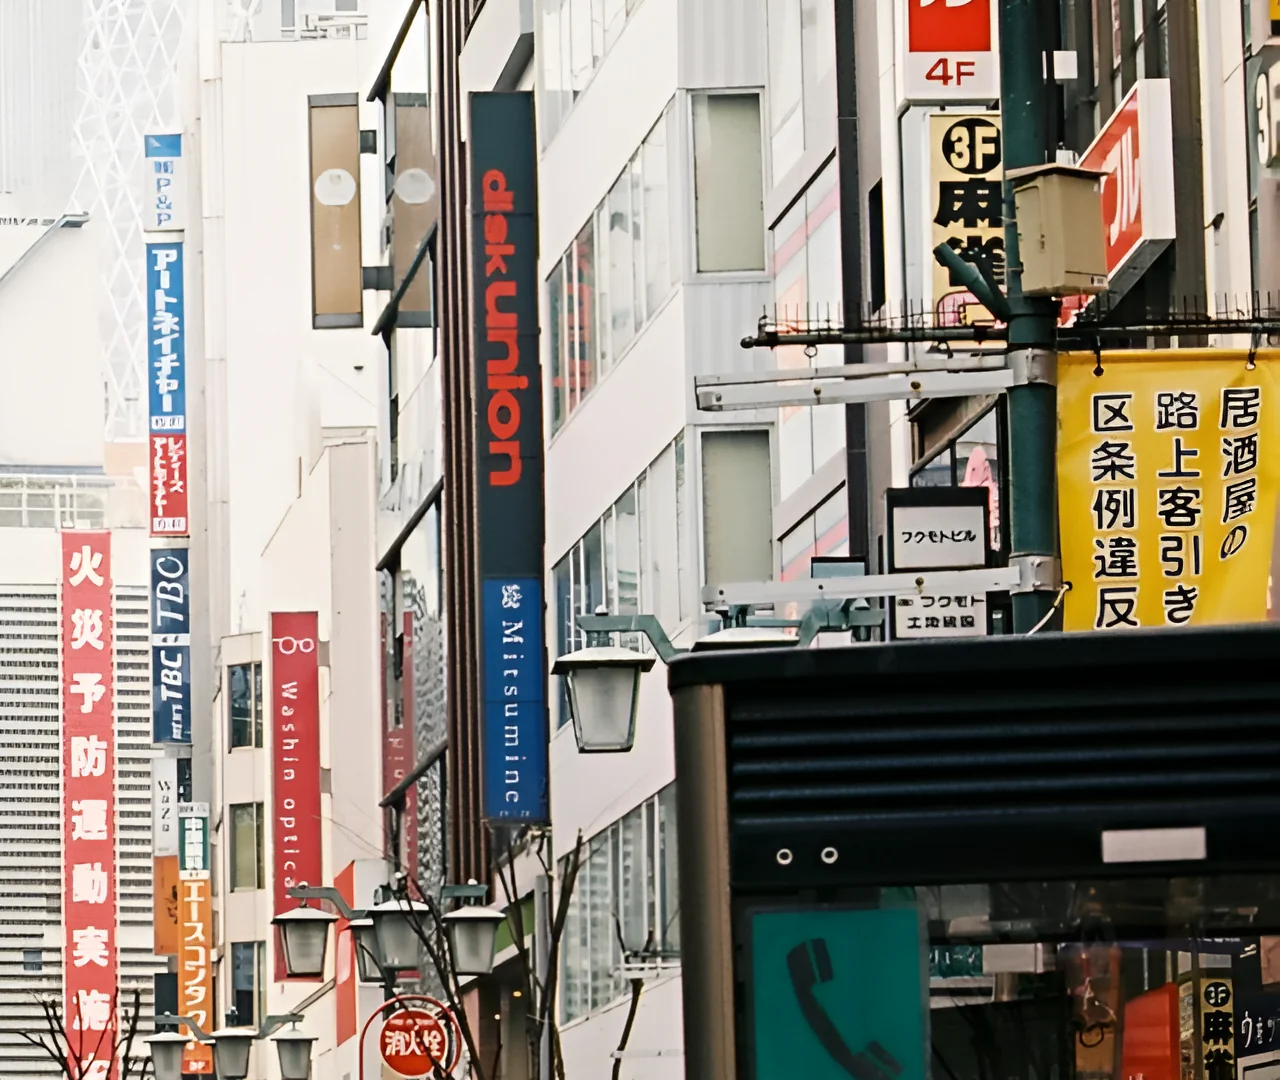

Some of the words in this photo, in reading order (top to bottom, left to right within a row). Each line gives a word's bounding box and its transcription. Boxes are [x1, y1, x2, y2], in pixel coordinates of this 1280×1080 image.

[925, 57, 976, 86] 4F
[949, 125, 998, 171] 3F
[1219, 387, 1262, 561] 居酒屋の
[1090, 393, 1139, 628] 区条例違反
[1155, 390, 1203, 626] 路上客引き
[901, 529, 977, 545] フクモトビル
[384, 1029, 443, 1057] 消火栓
